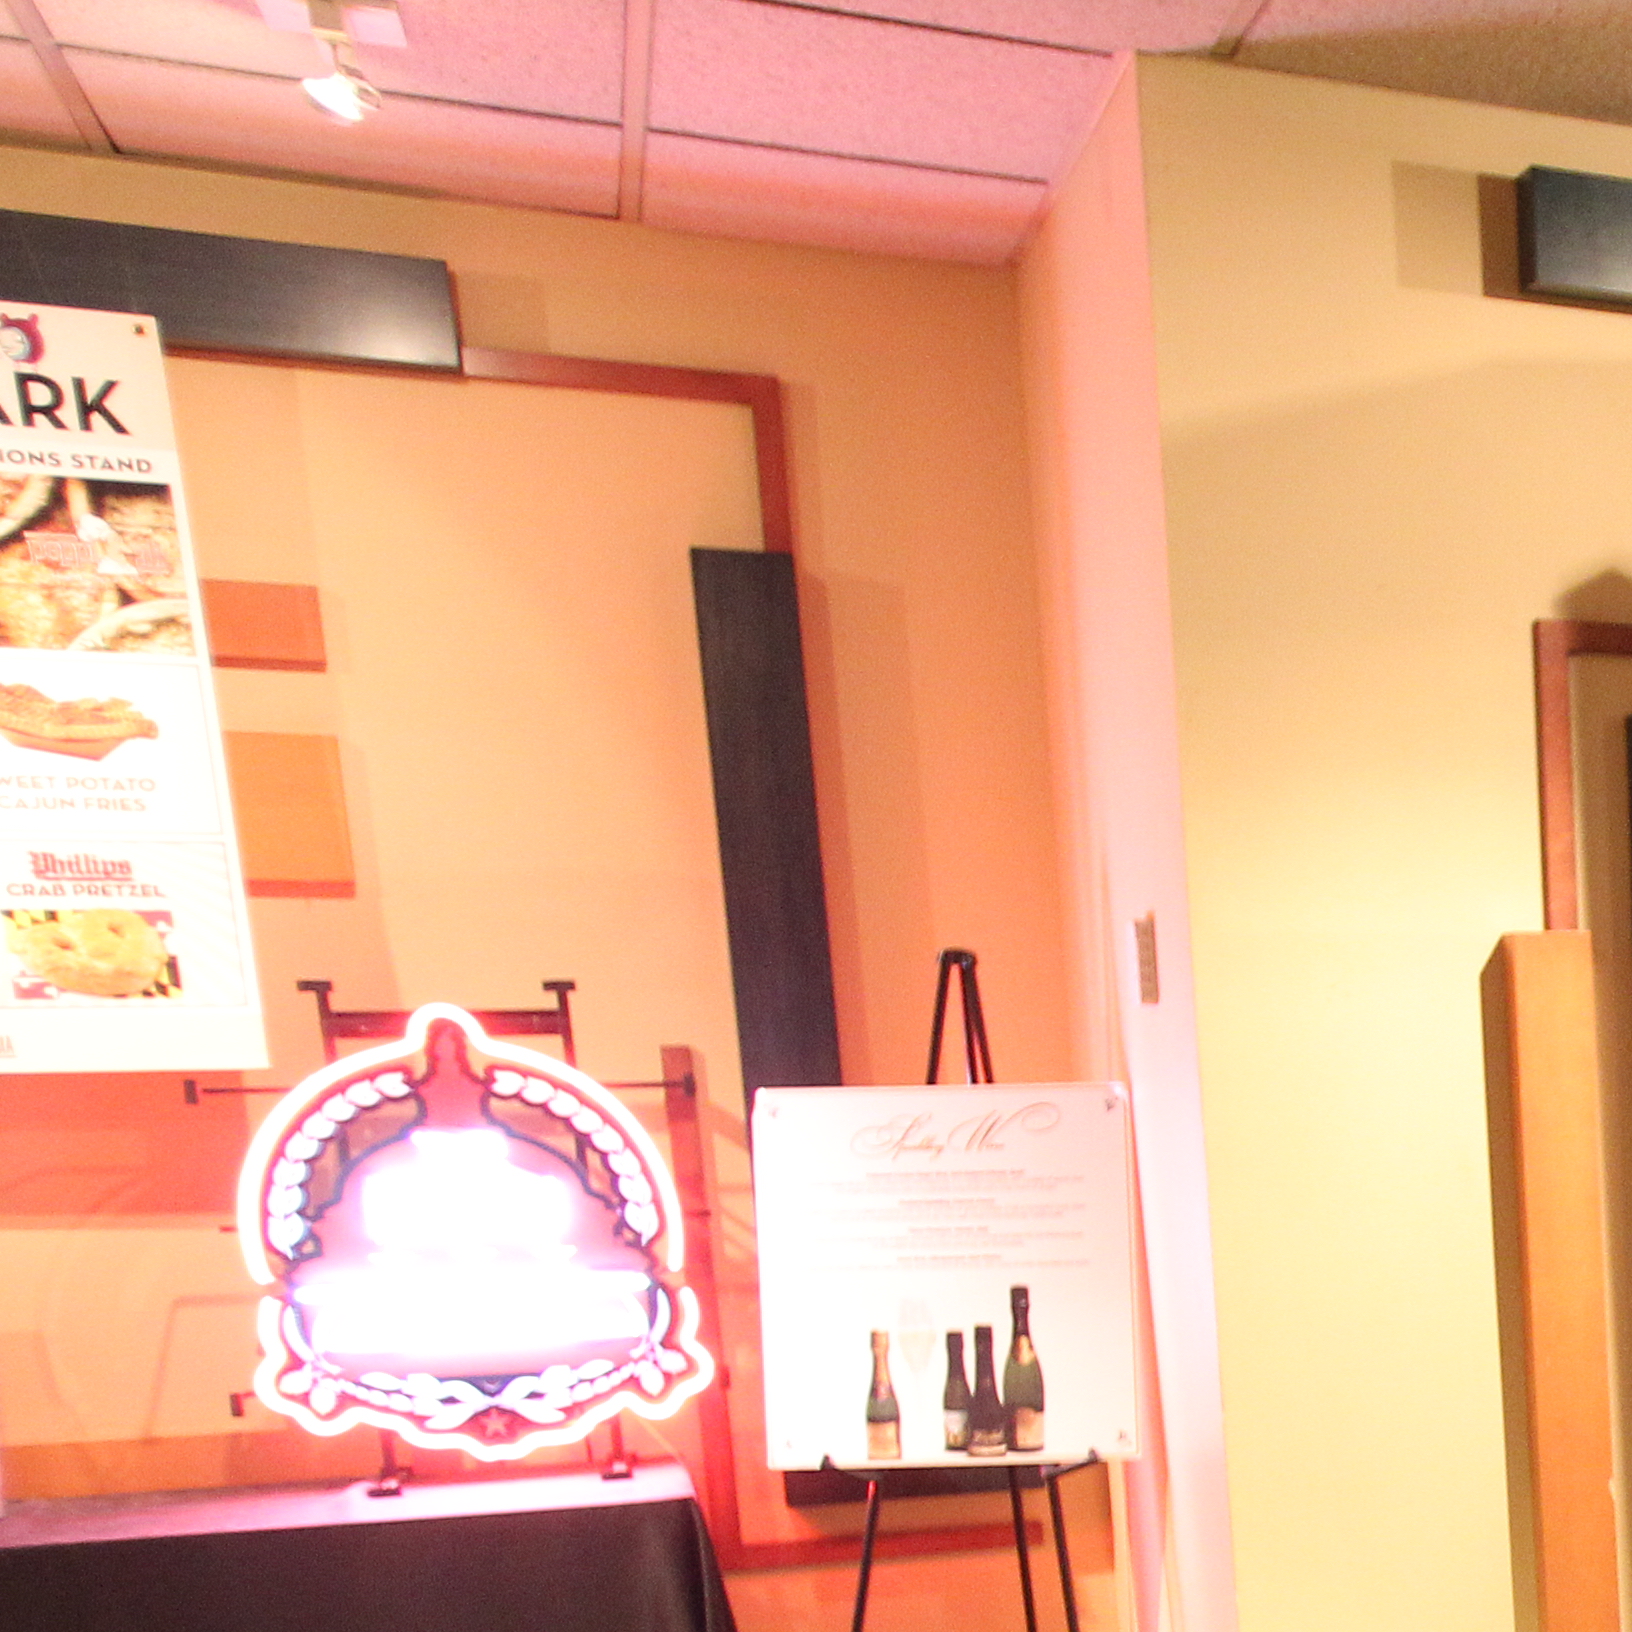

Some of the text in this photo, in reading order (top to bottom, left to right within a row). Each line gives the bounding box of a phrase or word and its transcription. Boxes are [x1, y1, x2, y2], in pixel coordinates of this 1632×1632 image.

[0, 372, 132, 435] RK
[71, 453, 152, 474] STAND
[66, 776, 156, 791] POTATO
[84, 797, 147, 811] FRIES
[6, 883, 166, 898] CRAB PRETZEL
